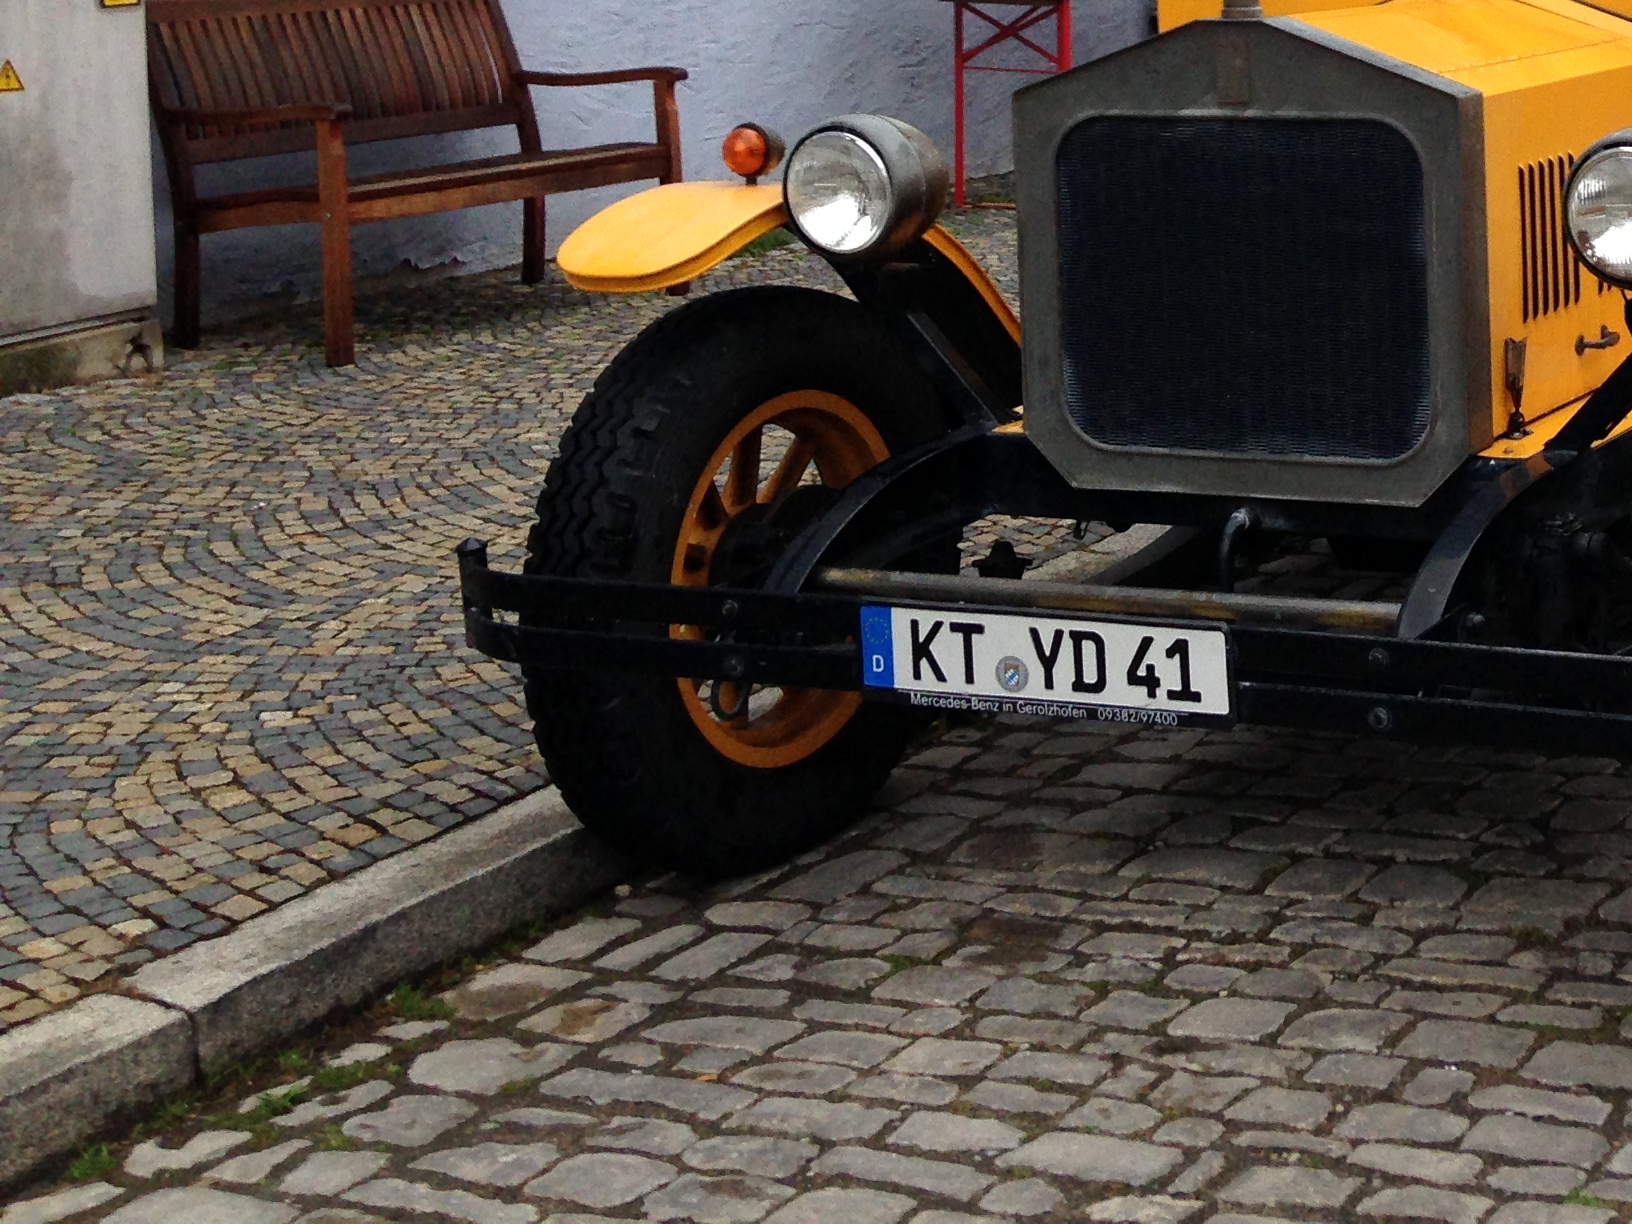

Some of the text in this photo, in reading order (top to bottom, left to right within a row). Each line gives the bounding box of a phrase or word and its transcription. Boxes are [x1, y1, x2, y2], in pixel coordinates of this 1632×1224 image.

[871, 618, 1203, 703] D KT YD 41
[910, 692, 1178, 726] Mercedes-Benz in Gerolzhofen 09382/97400
